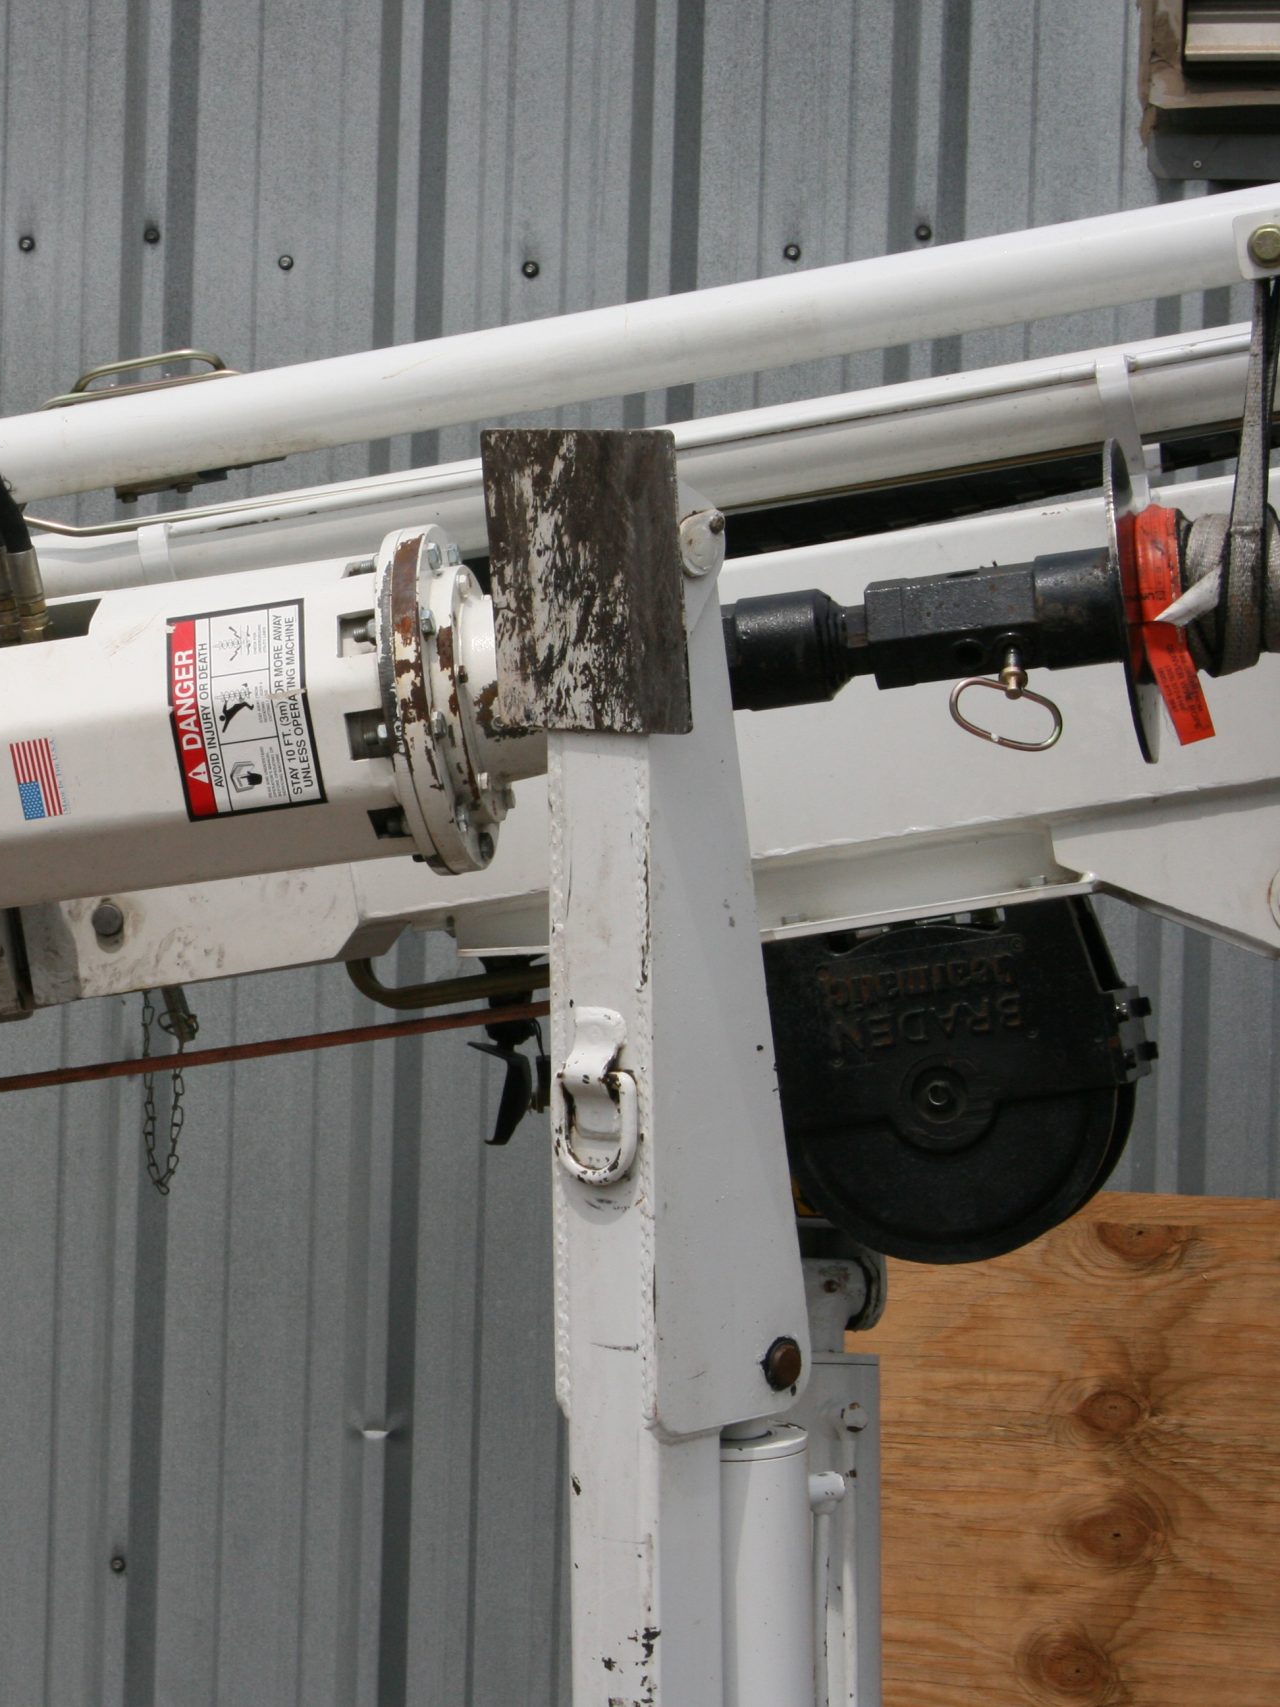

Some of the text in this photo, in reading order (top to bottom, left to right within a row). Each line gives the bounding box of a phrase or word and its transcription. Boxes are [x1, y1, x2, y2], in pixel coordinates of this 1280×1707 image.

[270, 614, 284, 642] AWAY
[270, 645, 285, 677] MORE
[175, 650, 202, 750] DANGER
[276, 701, 290, 726] (3m)
[280, 616, 314, 788] UNLESS OPERAING MACHINE
[197, 643, 224, 788] AVOID INJURY OR DEATH
[282, 729, 294, 746] FT.
[286, 750, 297, 762] 10
[288, 767, 302, 795] STAY
[828, 995, 1022, 1057] BRADEN
